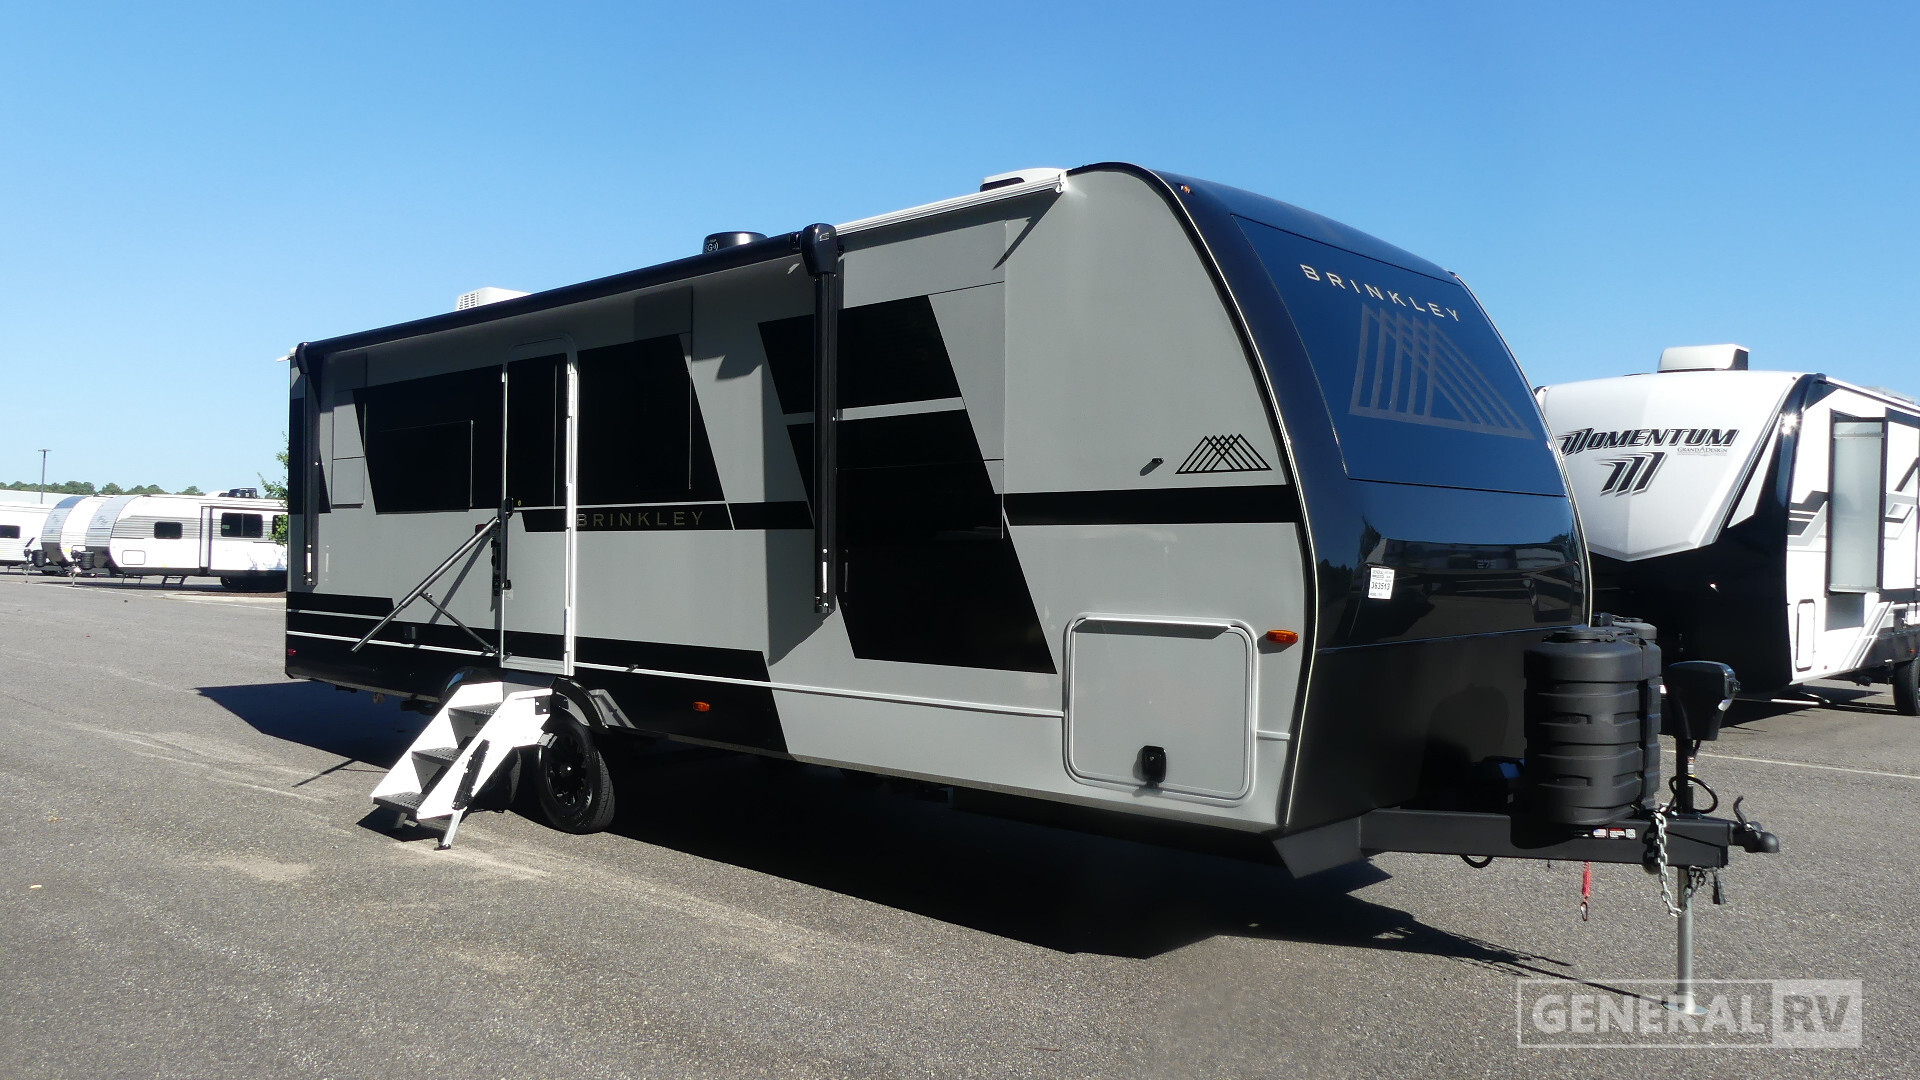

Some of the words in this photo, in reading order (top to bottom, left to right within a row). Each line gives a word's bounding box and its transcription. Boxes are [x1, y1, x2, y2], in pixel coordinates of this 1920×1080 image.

[1299, 263, 1460, 322] BRINKLEY
[1557, 427, 1740, 456] MOMENTUM
[576, 511, 703, 528] BRINKLEY
